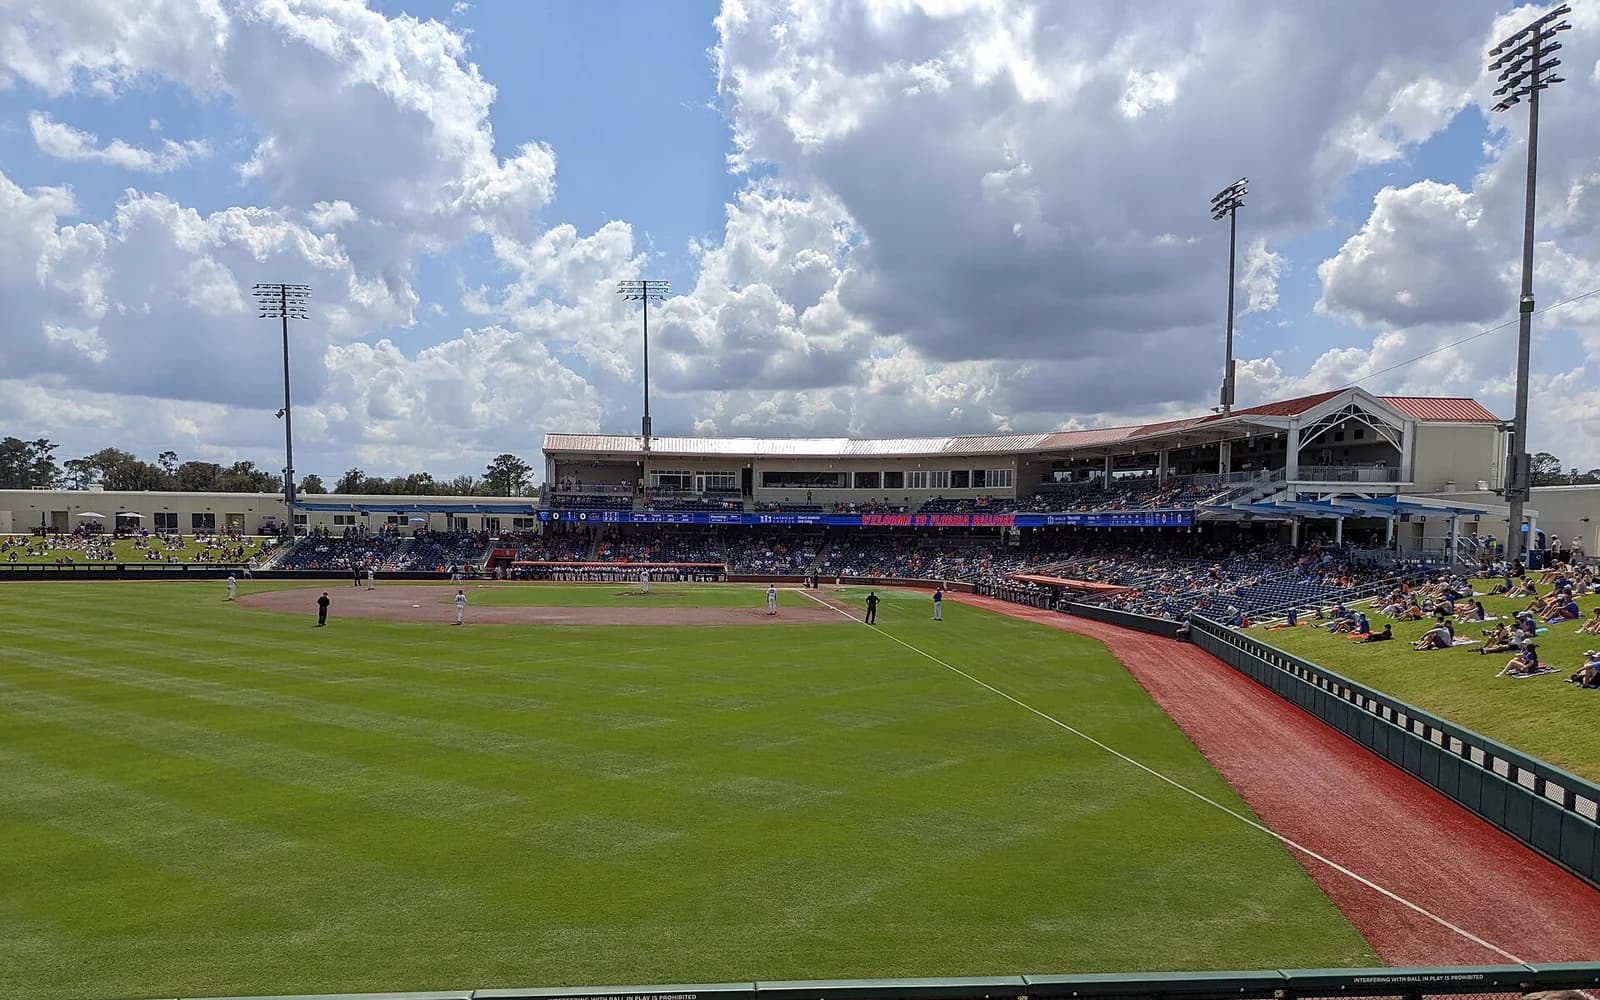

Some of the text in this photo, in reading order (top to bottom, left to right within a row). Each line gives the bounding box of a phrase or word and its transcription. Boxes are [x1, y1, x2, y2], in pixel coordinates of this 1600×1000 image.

[553, 512, 559, 520] 0
[580, 512, 586, 520] 0
[862, 514, 1015, 526] WELCOME TO FLORIDA BALLPARK
